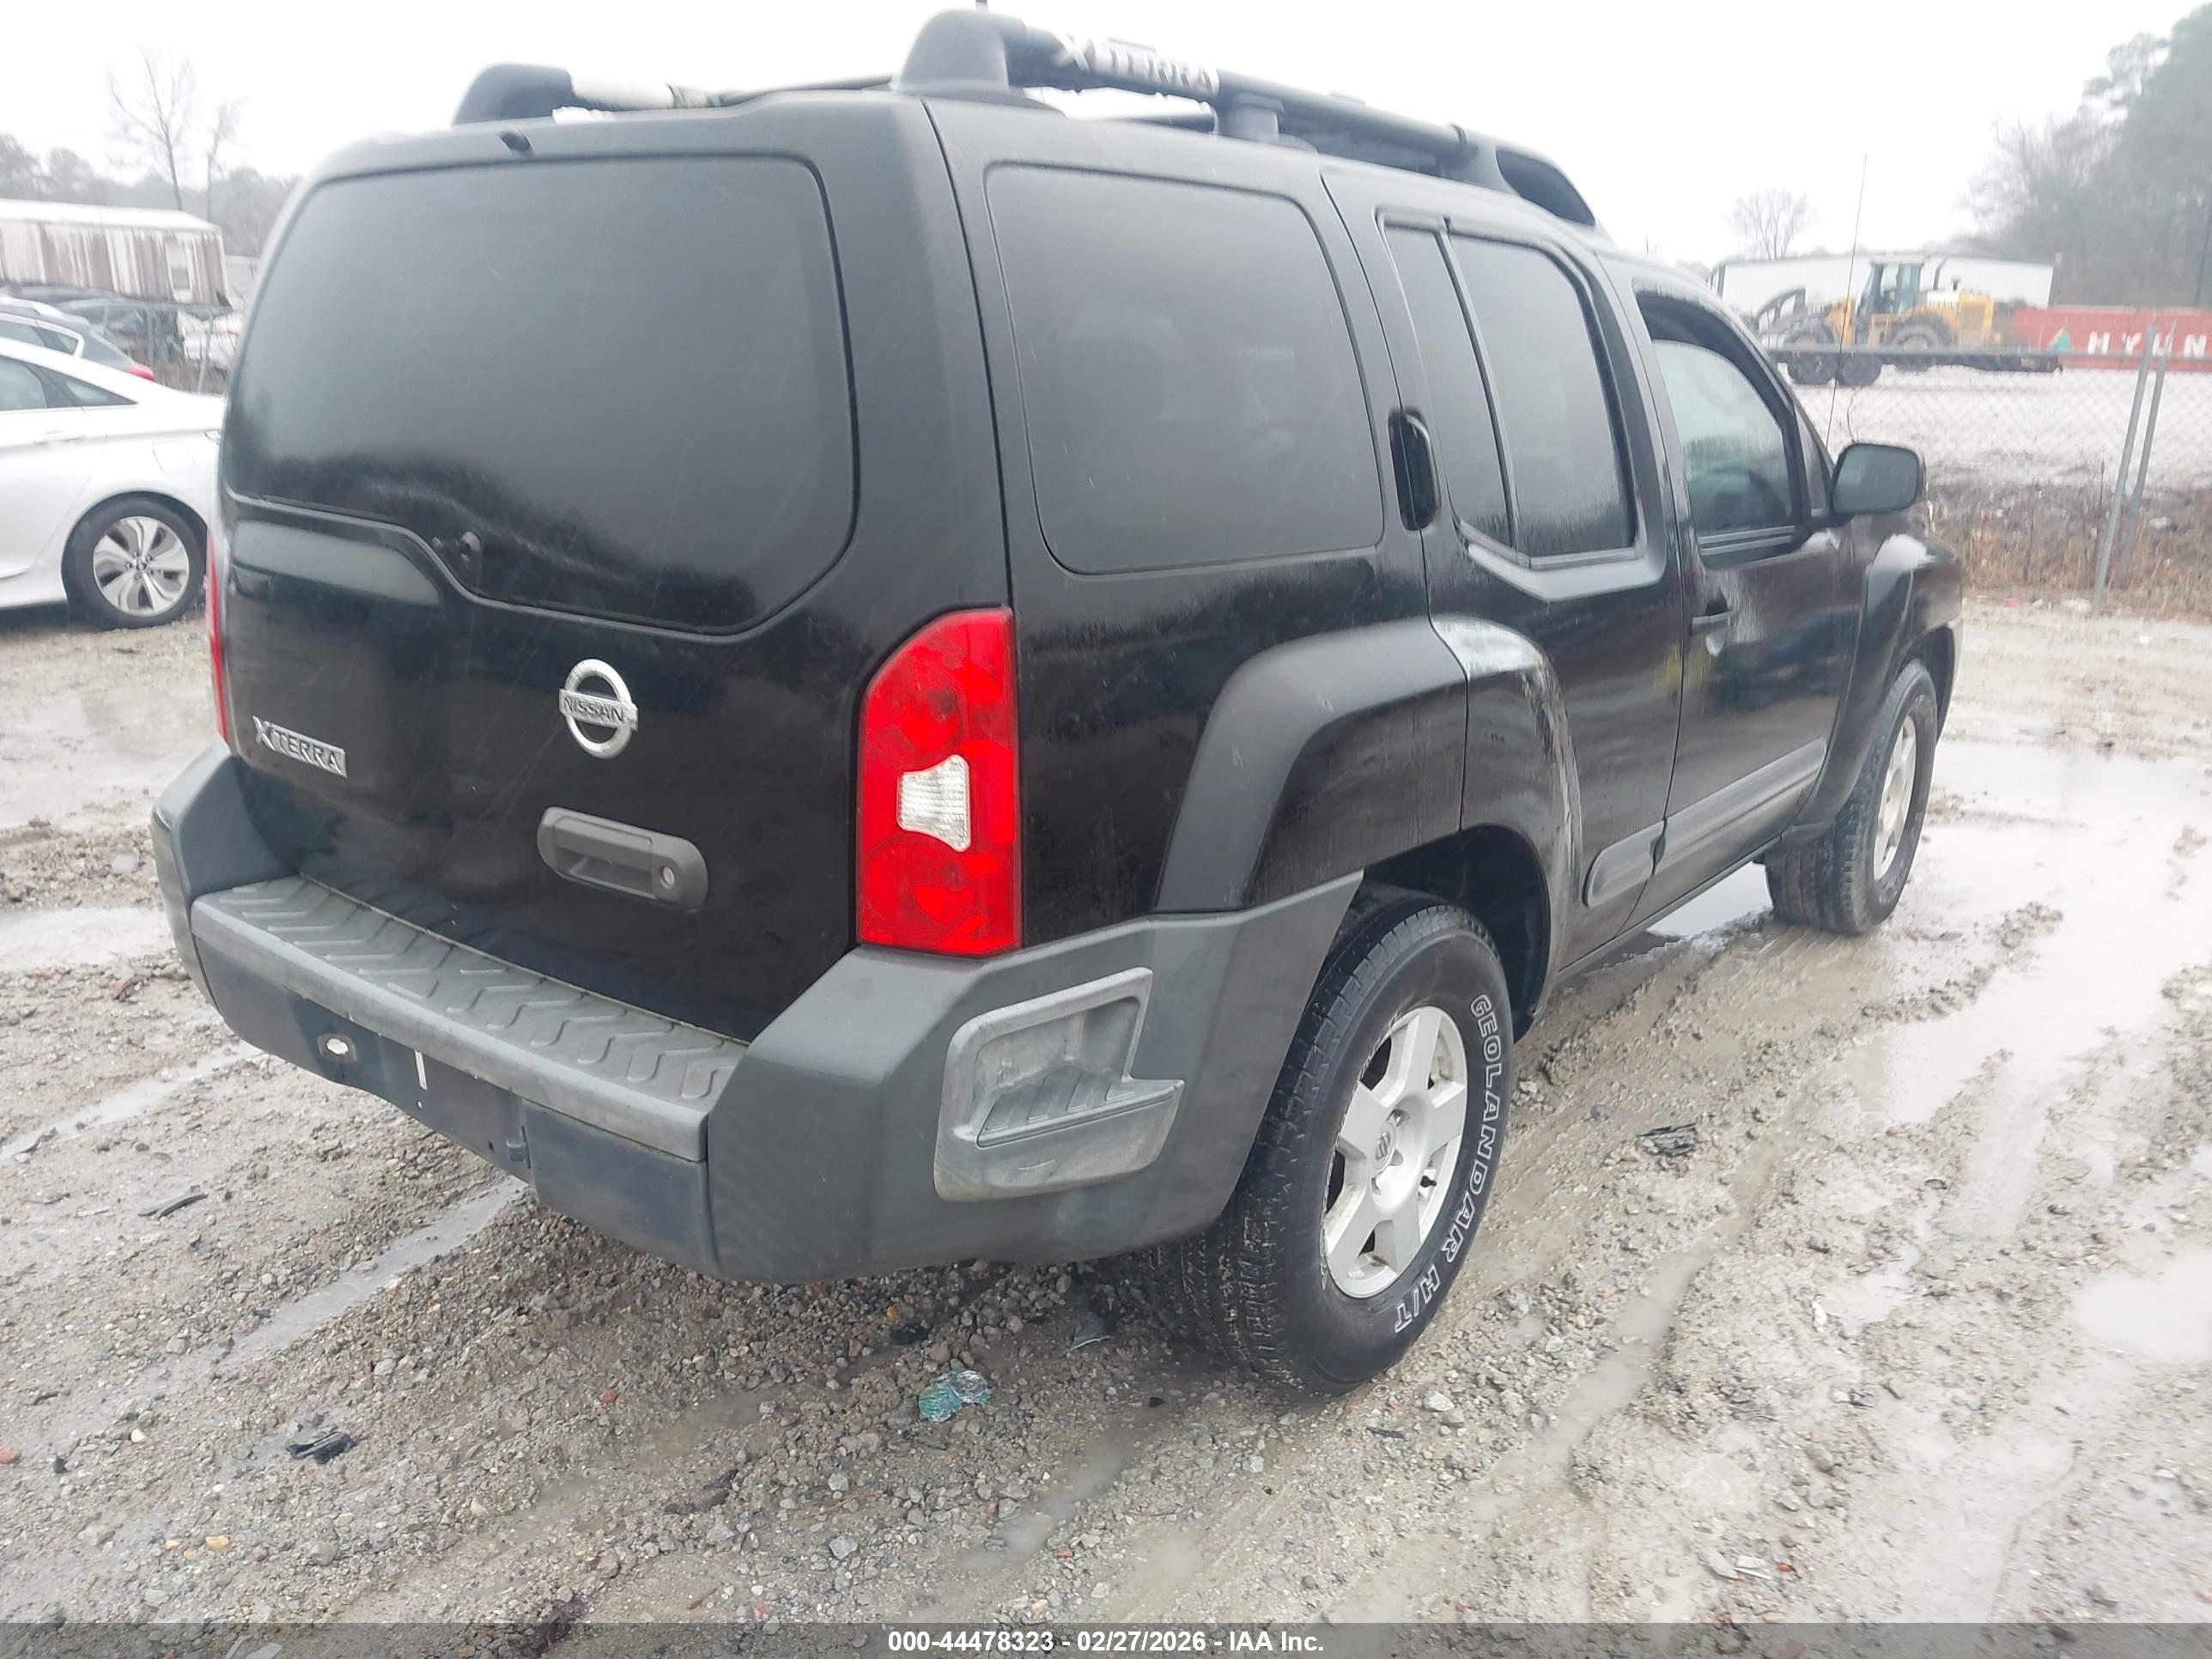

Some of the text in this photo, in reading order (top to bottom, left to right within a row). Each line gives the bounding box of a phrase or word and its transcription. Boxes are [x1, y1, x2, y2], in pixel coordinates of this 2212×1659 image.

[1052, 33, 1220, 96] XTERRA
[563, 697, 625, 724] NISSAN
[252, 715, 347, 778] XTERRA
[1395, 995, 1502, 1334] GEOLANDAR H/T
